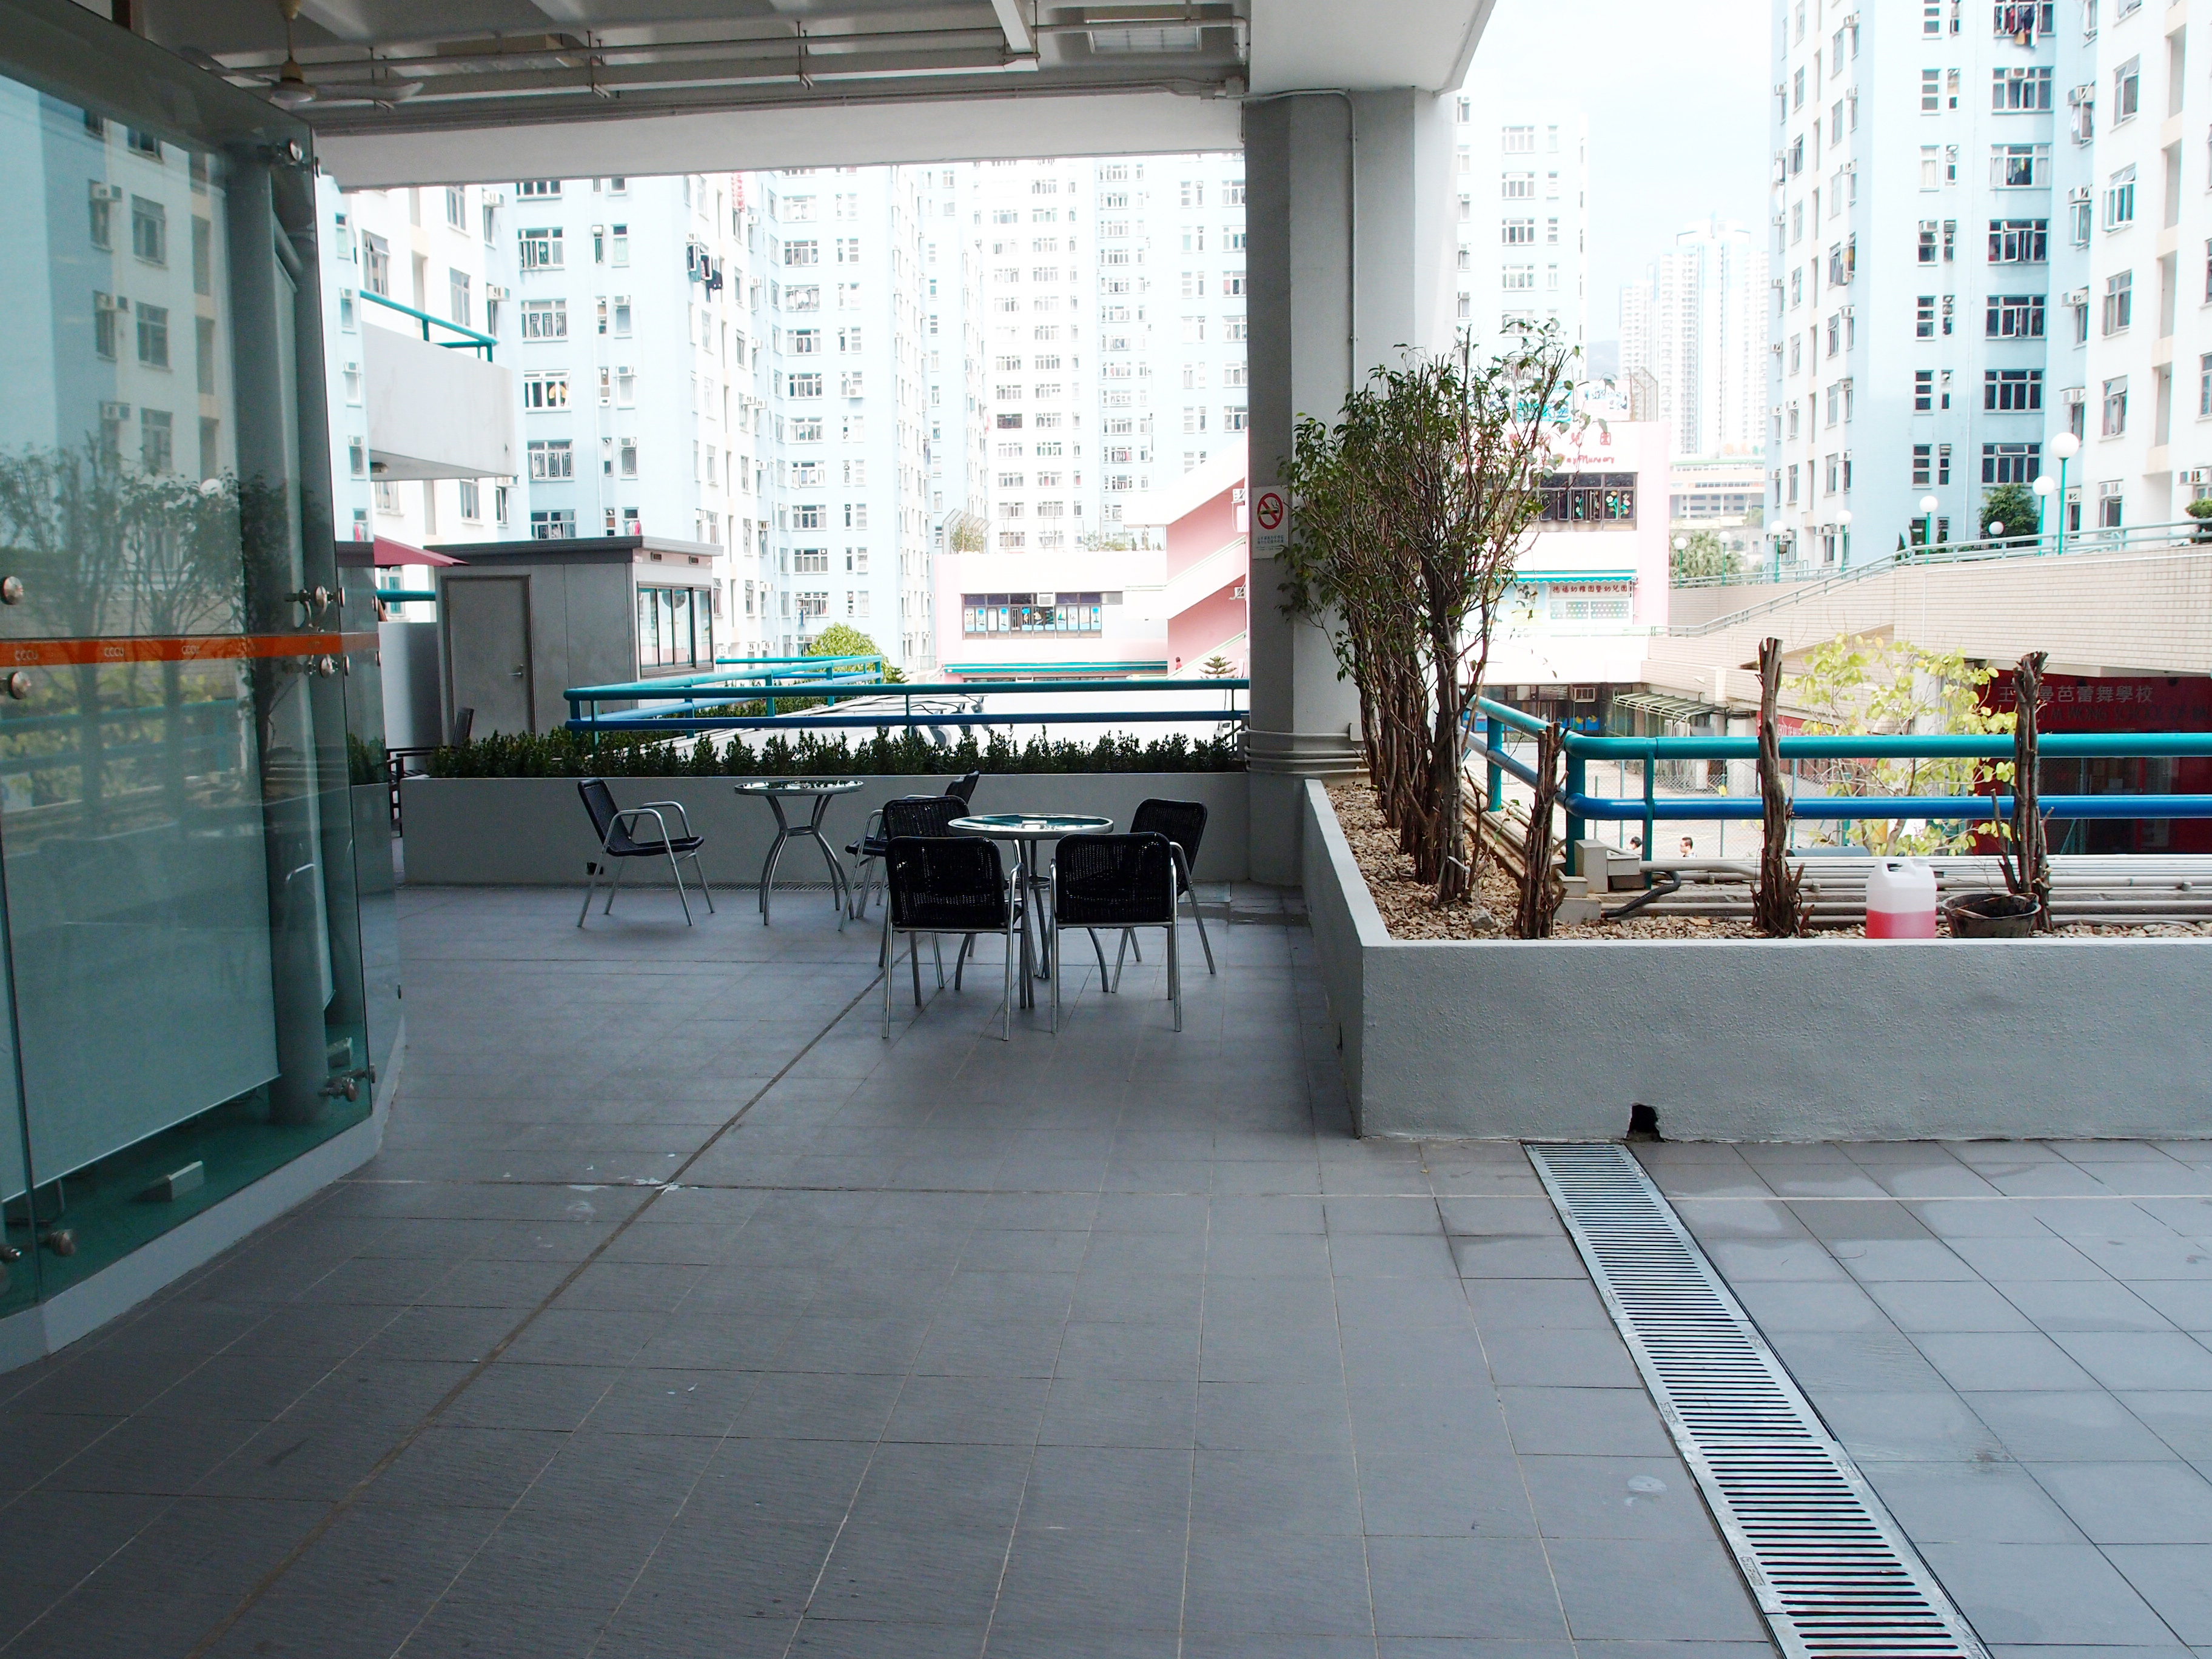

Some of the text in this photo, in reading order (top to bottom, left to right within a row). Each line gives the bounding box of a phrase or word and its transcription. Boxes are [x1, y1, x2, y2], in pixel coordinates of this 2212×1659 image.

[104, 646, 124, 657] CCCU
[1998, 686, 2154, 703] 王曼芭蕾舞學校
[2114, 705, 2163, 722] SCHOOL
